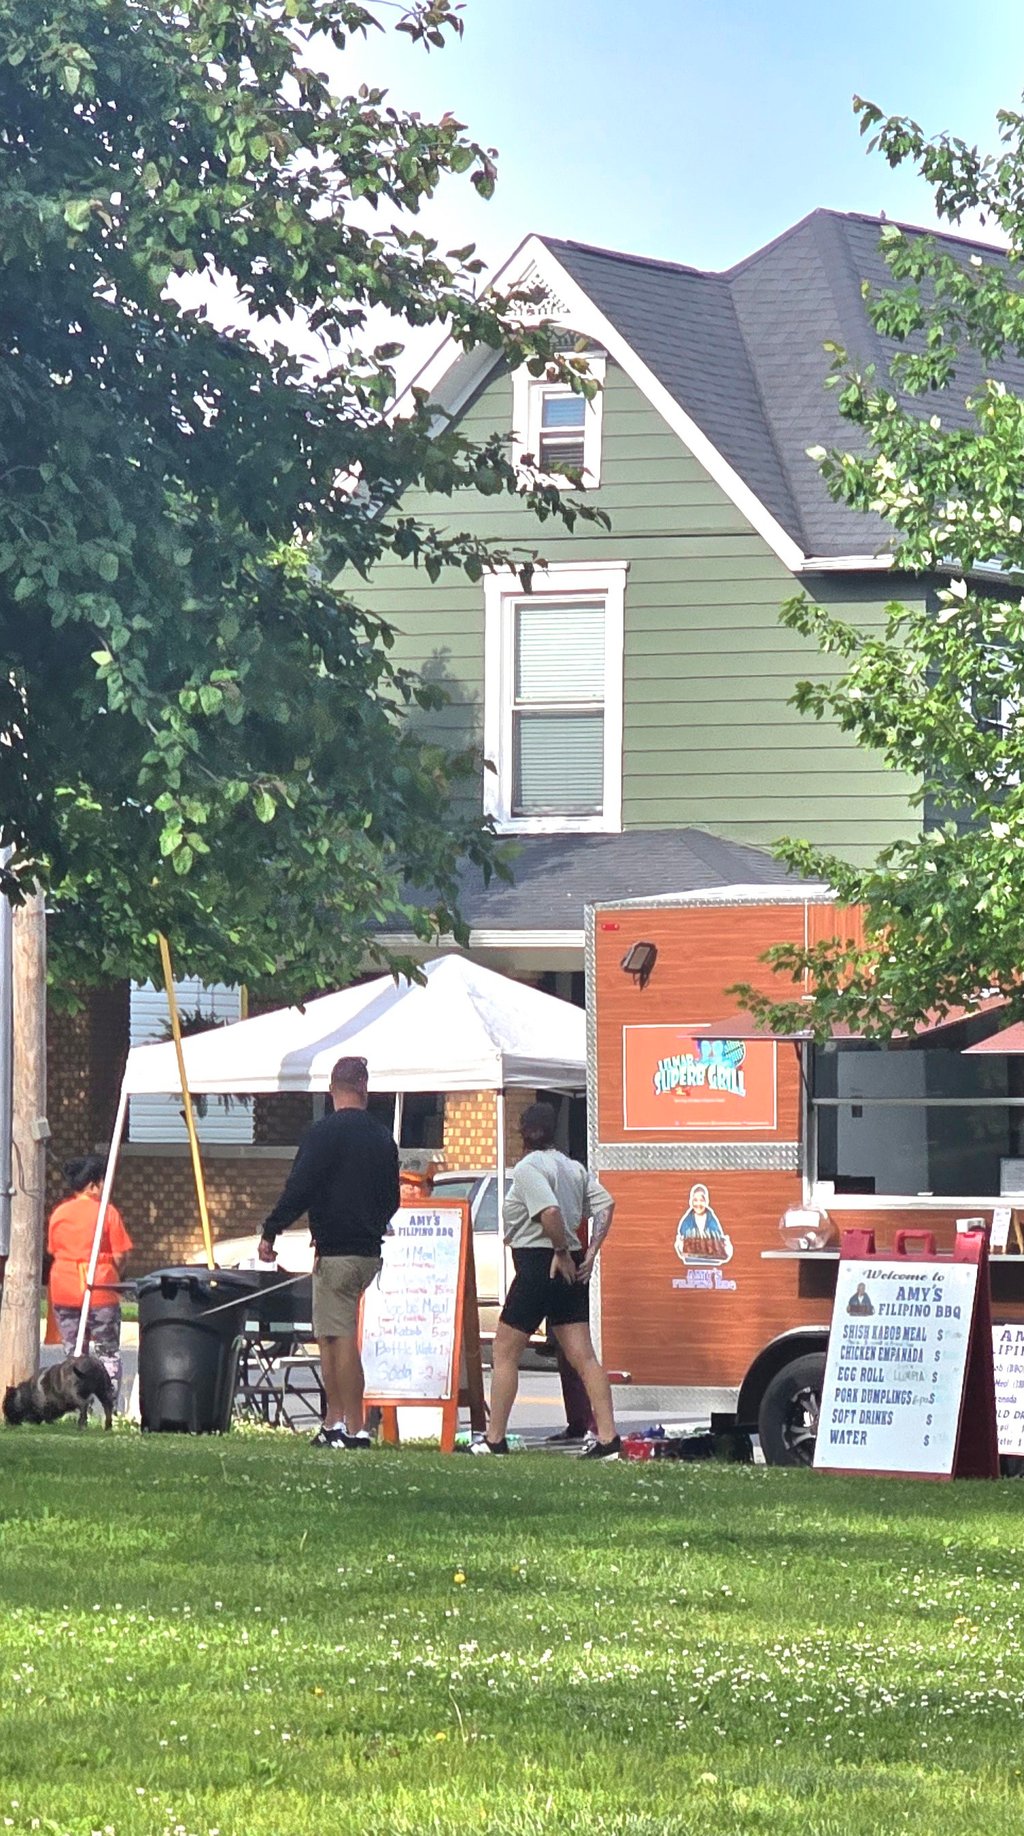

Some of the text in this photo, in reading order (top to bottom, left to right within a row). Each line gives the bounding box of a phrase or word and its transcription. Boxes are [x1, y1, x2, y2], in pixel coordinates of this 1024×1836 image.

[653, 1064, 747, 1098] SUPERB GRILL
[409, 1210, 441, 1226] AMY'S
[398, 1226, 454, 1238] FILIPINO BBQ
[862, 1269, 945, 1282] Welcome to
[895, 1284, 943, 1303] AMY'S
[877, 1303, 962, 1321] FILIPINO BBQ
[842, 1324, 871, 1340] SHISH
[871, 1325, 901, 1341] KABOB
[902, 1326, 927, 1342] MEAL
[840, 1345, 877, 1361] CHICKEN
[877, 1346, 924, 1363] EMPANADA
[837, 1366, 857, 1382] EGG
[859, 1366, 885, 1383] ROLL
[834, 1387, 859, 1403] PORK
[860, 1387, 913, 1405] DUMPLINGS
[831, 1408, 857, 1424] SOFT
[859, 1408, 894, 1426] DRINKS
[997, 1409, 1010, 1419] LD
[829, 1429, 868, 1446] WATER
